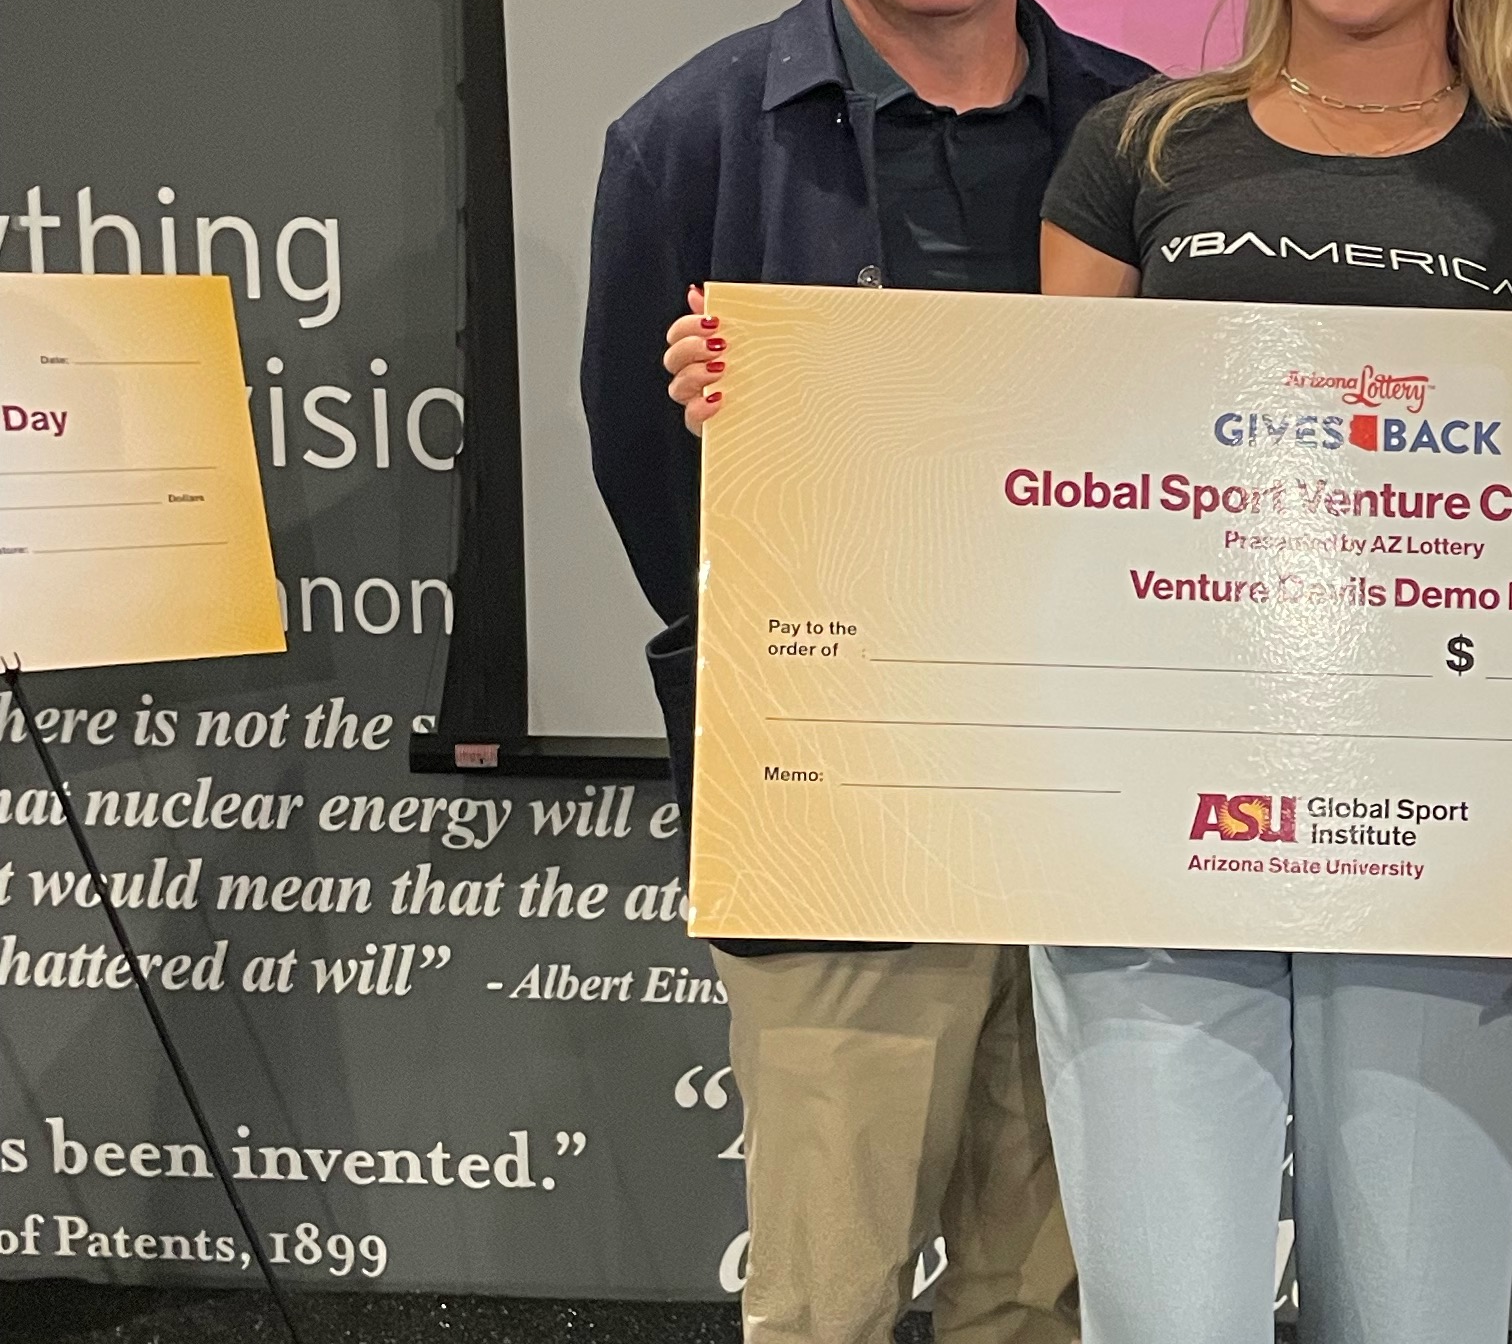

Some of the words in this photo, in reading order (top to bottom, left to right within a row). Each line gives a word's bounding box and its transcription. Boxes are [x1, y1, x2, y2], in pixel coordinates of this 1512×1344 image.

[1287, 371, 1356, 388] Arizona
[1342, 364, 1429, 413] Lottery
[1, 405, 68, 437] Day
[245, 356, 464, 474] isio
[1214, 412, 1344, 450] GIVES
[1383, 418, 1502, 455] BACK
[1005, 468, 1150, 512] Global
[1371, 535, 1402, 554] AZ
[1407, 537, 1485, 559] Lottery
[1130, 570, 1269, 603] Venture
[1394, 578, 1501, 610] Demo
[768, 619, 801, 638] Pay
[806, 620, 824, 635] to
[829, 621, 857, 636] the
[768, 641, 817, 656] order
[820, 642, 839, 657] of
[1445, 633, 1475, 677] $
[134, 693, 178, 747] is
[195, 703, 291, 749] not
[304, 696, 393, 751] the
[764, 766, 824, 782] Memo:
[84, 776, 304, 830] nuclear
[318, 795, 512, 850] energy
[529, 785, 635, 838] will
[1189, 793, 1297, 843] ASU
[1307, 796, 1390, 819] Global
[1396, 798, 1469, 825] Sport
[1311, 823, 1417, 847] Institute
[1187, 855, 1264, 873] Arizona
[1269, 857, 1321, 875] State
[1326, 859, 1425, 880] University
[216, 875, 372, 914] mean
[390, 862, 505, 917] that
[518, 866, 609, 920] the
[242, 948, 298, 993] at
[310, 943, 451, 996] will”
[508, 963, 634, 1002] Albert
[44, 1116, 214, 1178] been
[231, 1124, 587, 1191] invented.”
[52, 1215, 251, 1271] Patents,
[269, 1222, 387, 1278] 1899
